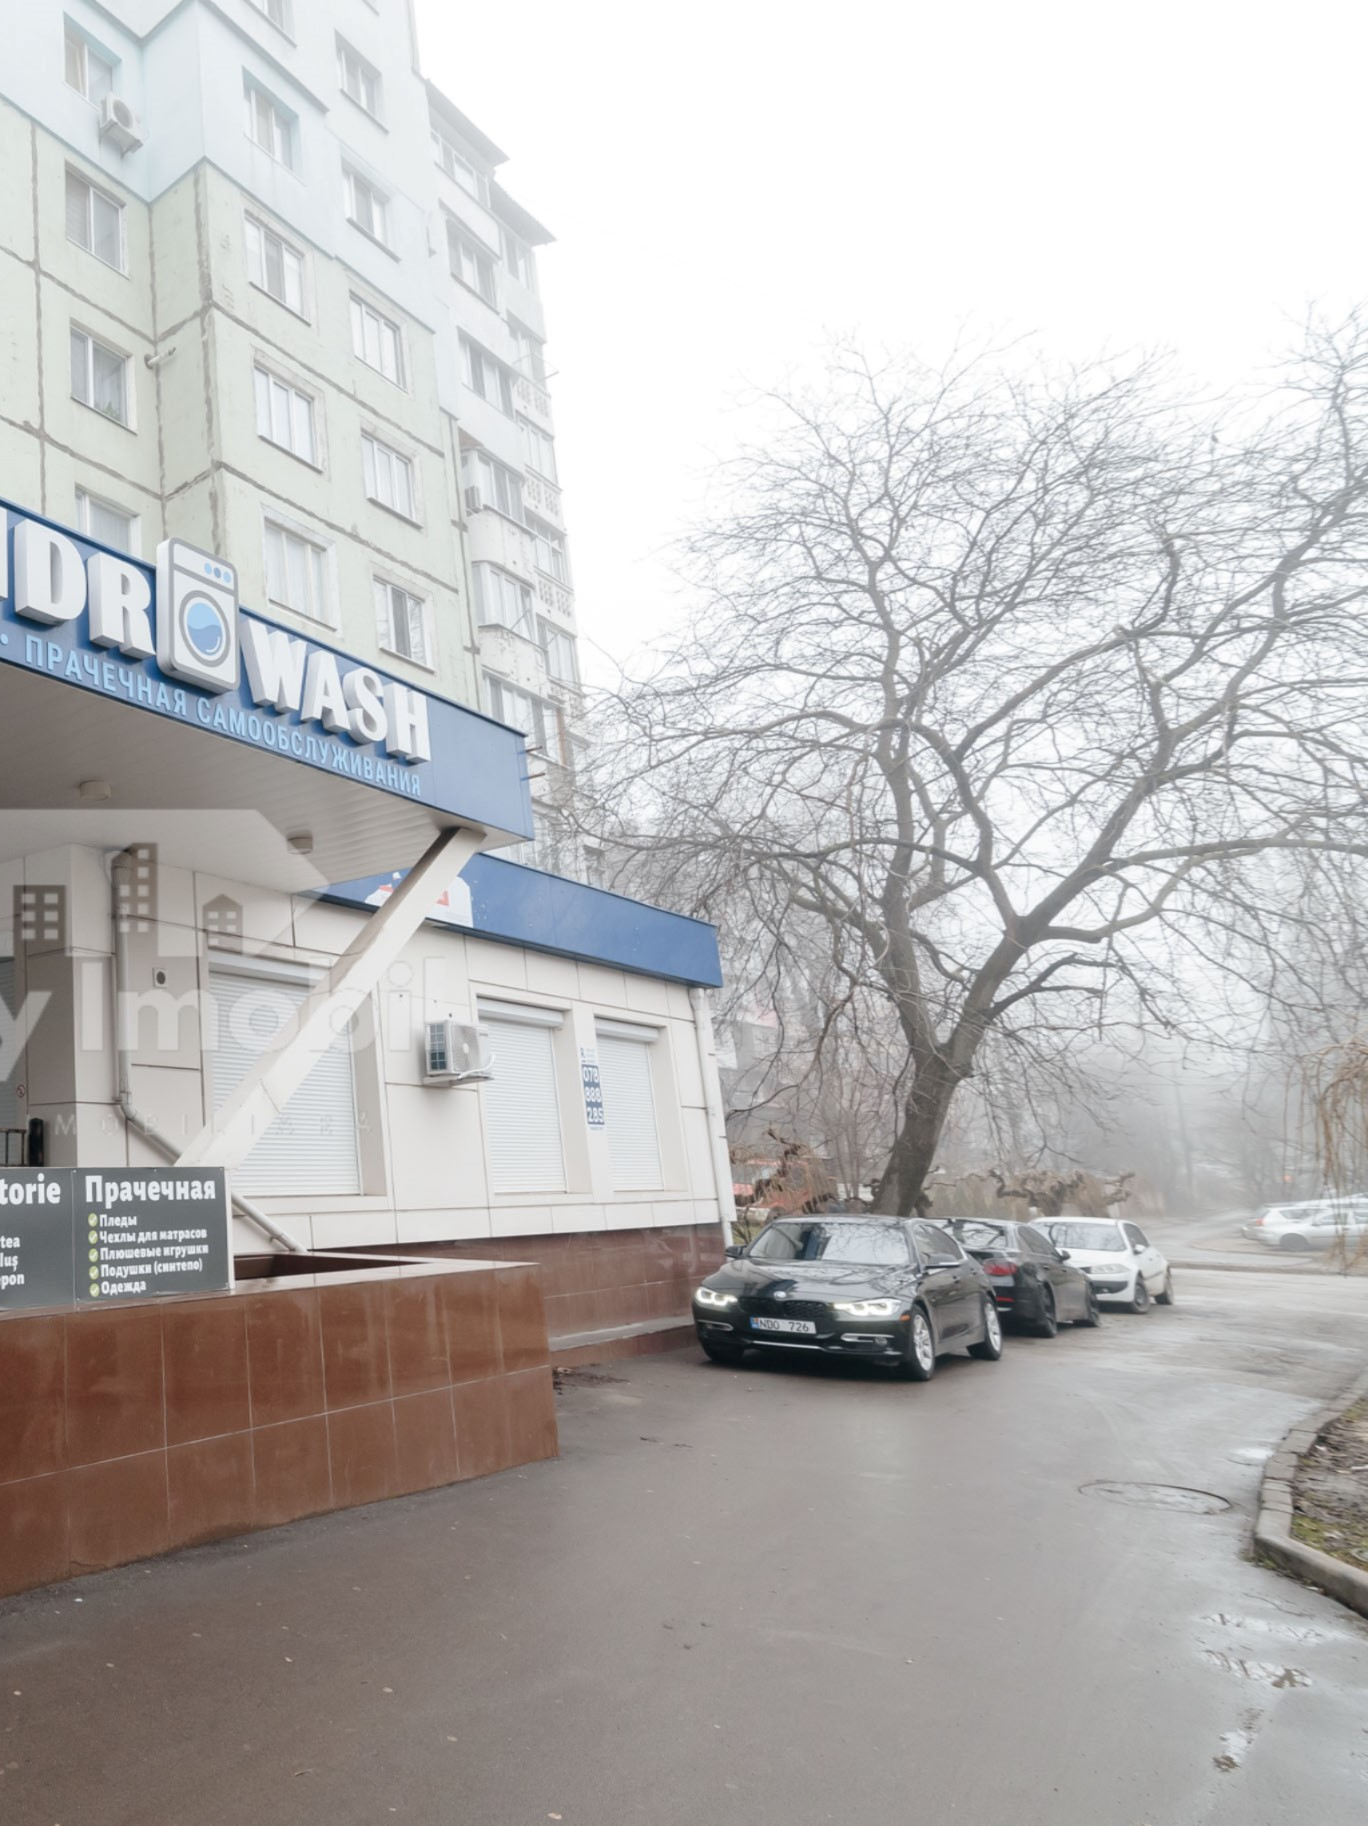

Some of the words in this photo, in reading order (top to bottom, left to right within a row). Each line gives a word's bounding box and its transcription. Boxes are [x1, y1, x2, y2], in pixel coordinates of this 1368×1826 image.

[239, 617, 431, 764] WASH
[25, 633, 188, 718] ПРАЧЕЧНАЯ
[196, 696, 421, 797] САМООБСЛУЖИВАНИЯ
[85, 1175, 216, 1208] Прачечная
[99, 1214, 137, 1228] Пледы
[99, 1230, 136, 1243] Чехлы
[138, 1231, 157, 1243] для
[159, 1229, 207, 1242] матрасов
[100, 1246, 161, 1260] Плюшевые
[163, 1244, 209, 1258] игрушки
[100, 1264, 152, 1278] Подушки
[154, 1258, 203, 1275] (синтепо)
[101, 1281, 147, 1295] Одежда
[788, 1321, 809, 1332] 726
